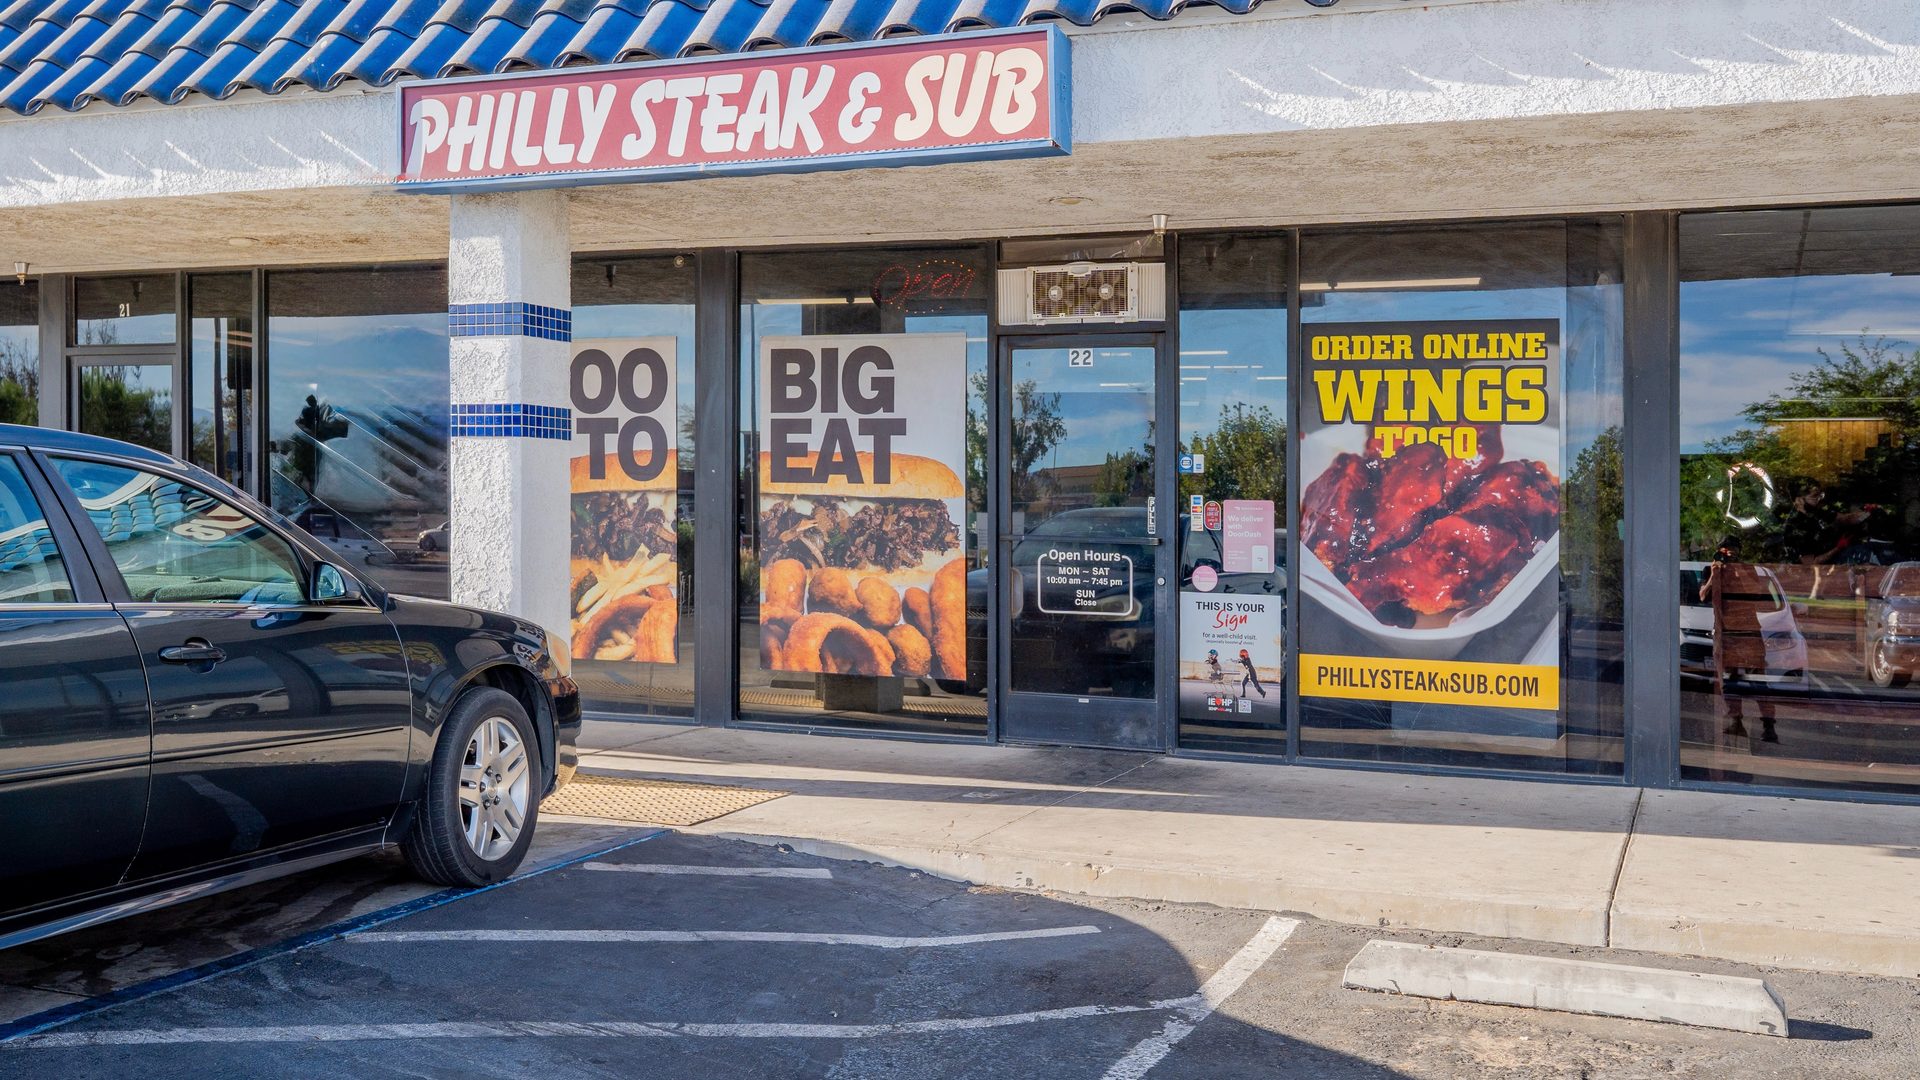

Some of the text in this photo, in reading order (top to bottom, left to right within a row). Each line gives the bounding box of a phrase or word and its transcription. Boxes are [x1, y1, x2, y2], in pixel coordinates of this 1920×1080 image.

[405, 48, 1044, 181] PHILLY STEAK & SUB
[119, 303, 130, 318] 21
[1312, 333, 1546, 360] ORDER ONLINE
[1071, 350, 1091, 366] 22
[770, 345, 895, 415] BIG
[1313, 368, 1546, 422] WINGS
[770, 418, 907, 485] EAT
[1049, 549, 1121, 562] Open Hours
[1058, 567, 1080, 575] MON
[1092, 567, 1110, 576] SAT
[1046, 576, 1067, 584] 10:00
[1091, 577, 1108, 585] 7:45
[1110, 579, 1122, 587] pm
[1076, 590, 1095, 598] SUN
[1074, 598, 1097, 606] Close
[1196, 601, 1265, 612] THIS IS YOUR
[1212, 609, 1248, 631] Sign
